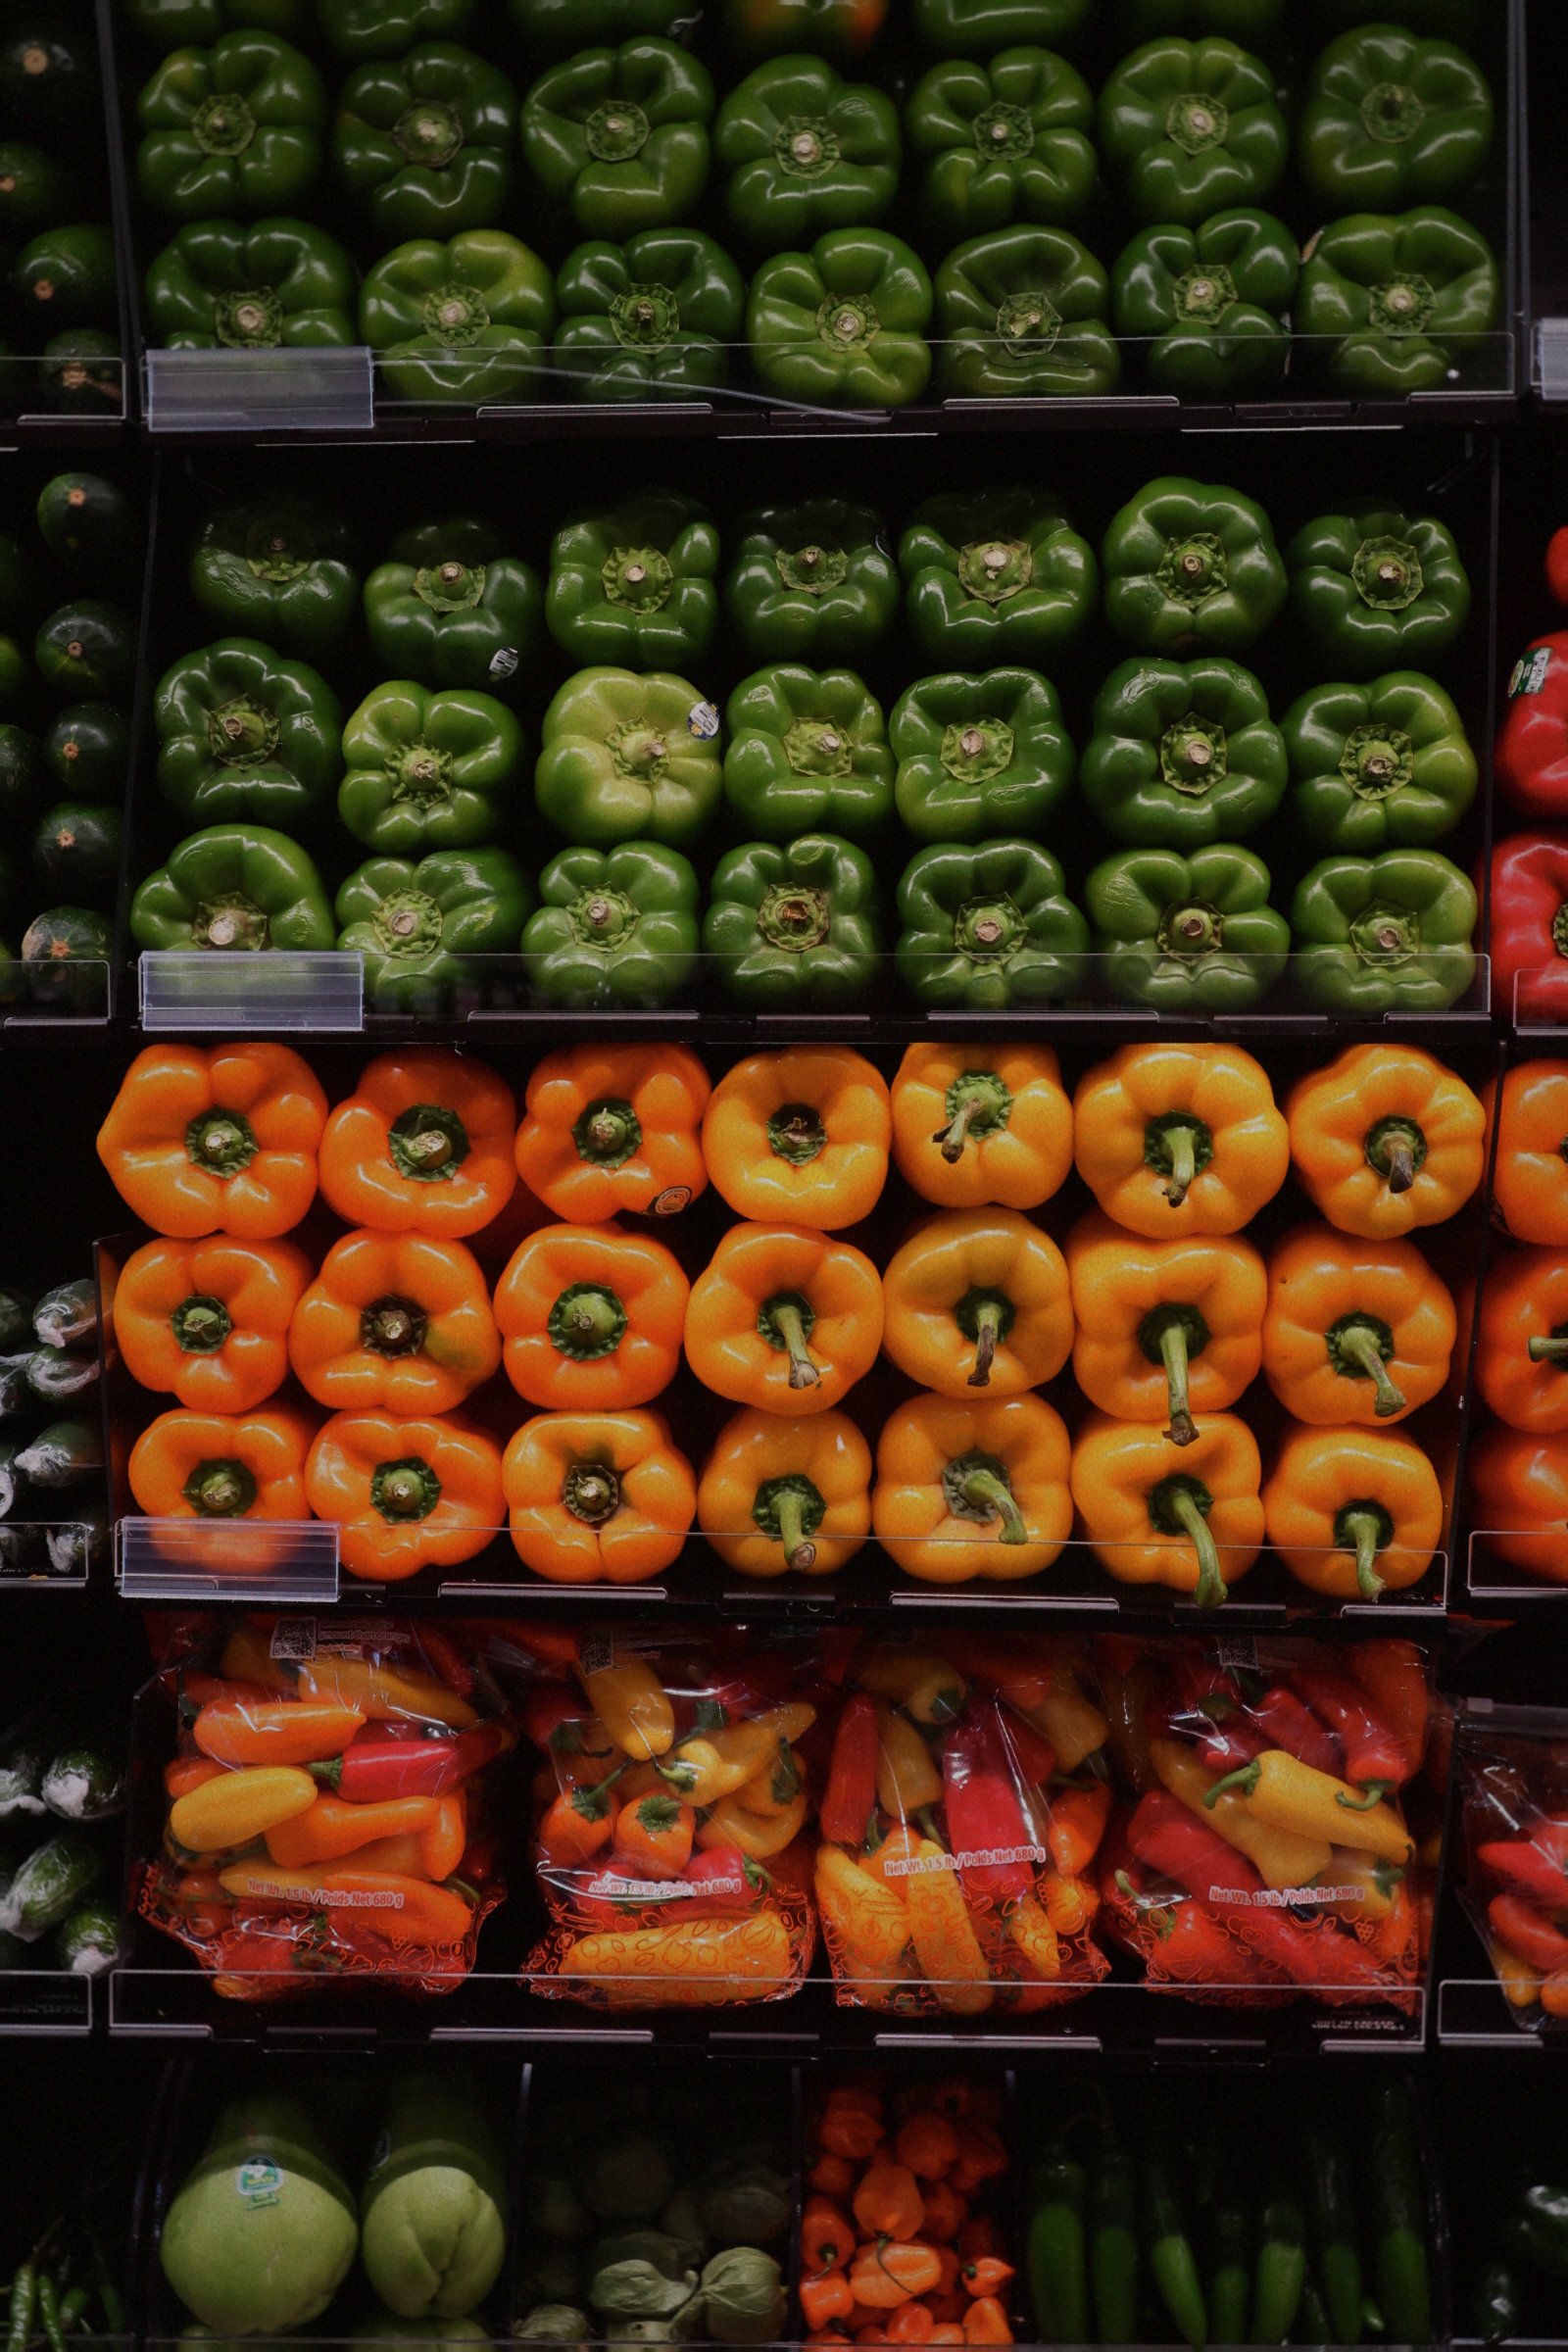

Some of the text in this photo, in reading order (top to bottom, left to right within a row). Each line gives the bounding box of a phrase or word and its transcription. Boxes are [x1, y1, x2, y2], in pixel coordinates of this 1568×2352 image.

[886, 1862, 904, 1875] Net
[906, 1860, 925, 1872] Wt.
[928, 1858, 943, 1870] 1.5
[945, 1856, 955, 1869] lb
[965, 1851, 992, 1866] Poids
[994, 1850, 1011, 1864] Net
[1014, 1847, 1035, 1861] 680
[248, 1880, 266, 1892] Net
[267, 1883, 283, 1896] Wt.
[285, 1886, 300, 1900] 1.5
[302, 1888, 313, 1901] lb
[321, 1891, 349, 1905] Poids
[352, 1893, 371, 1905] Net
[372, 1893, 393, 1906] 680
[711, 1880, 731, 1893] 680
[1210, 1887, 1229, 1901] Net
[1252, 1892, 1268, 1906] 1.5
[1270, 1891, 1280, 1905] lb
[1316, 1887, 1334, 1901] Net
[1335, 1886, 1354, 1899] 680
